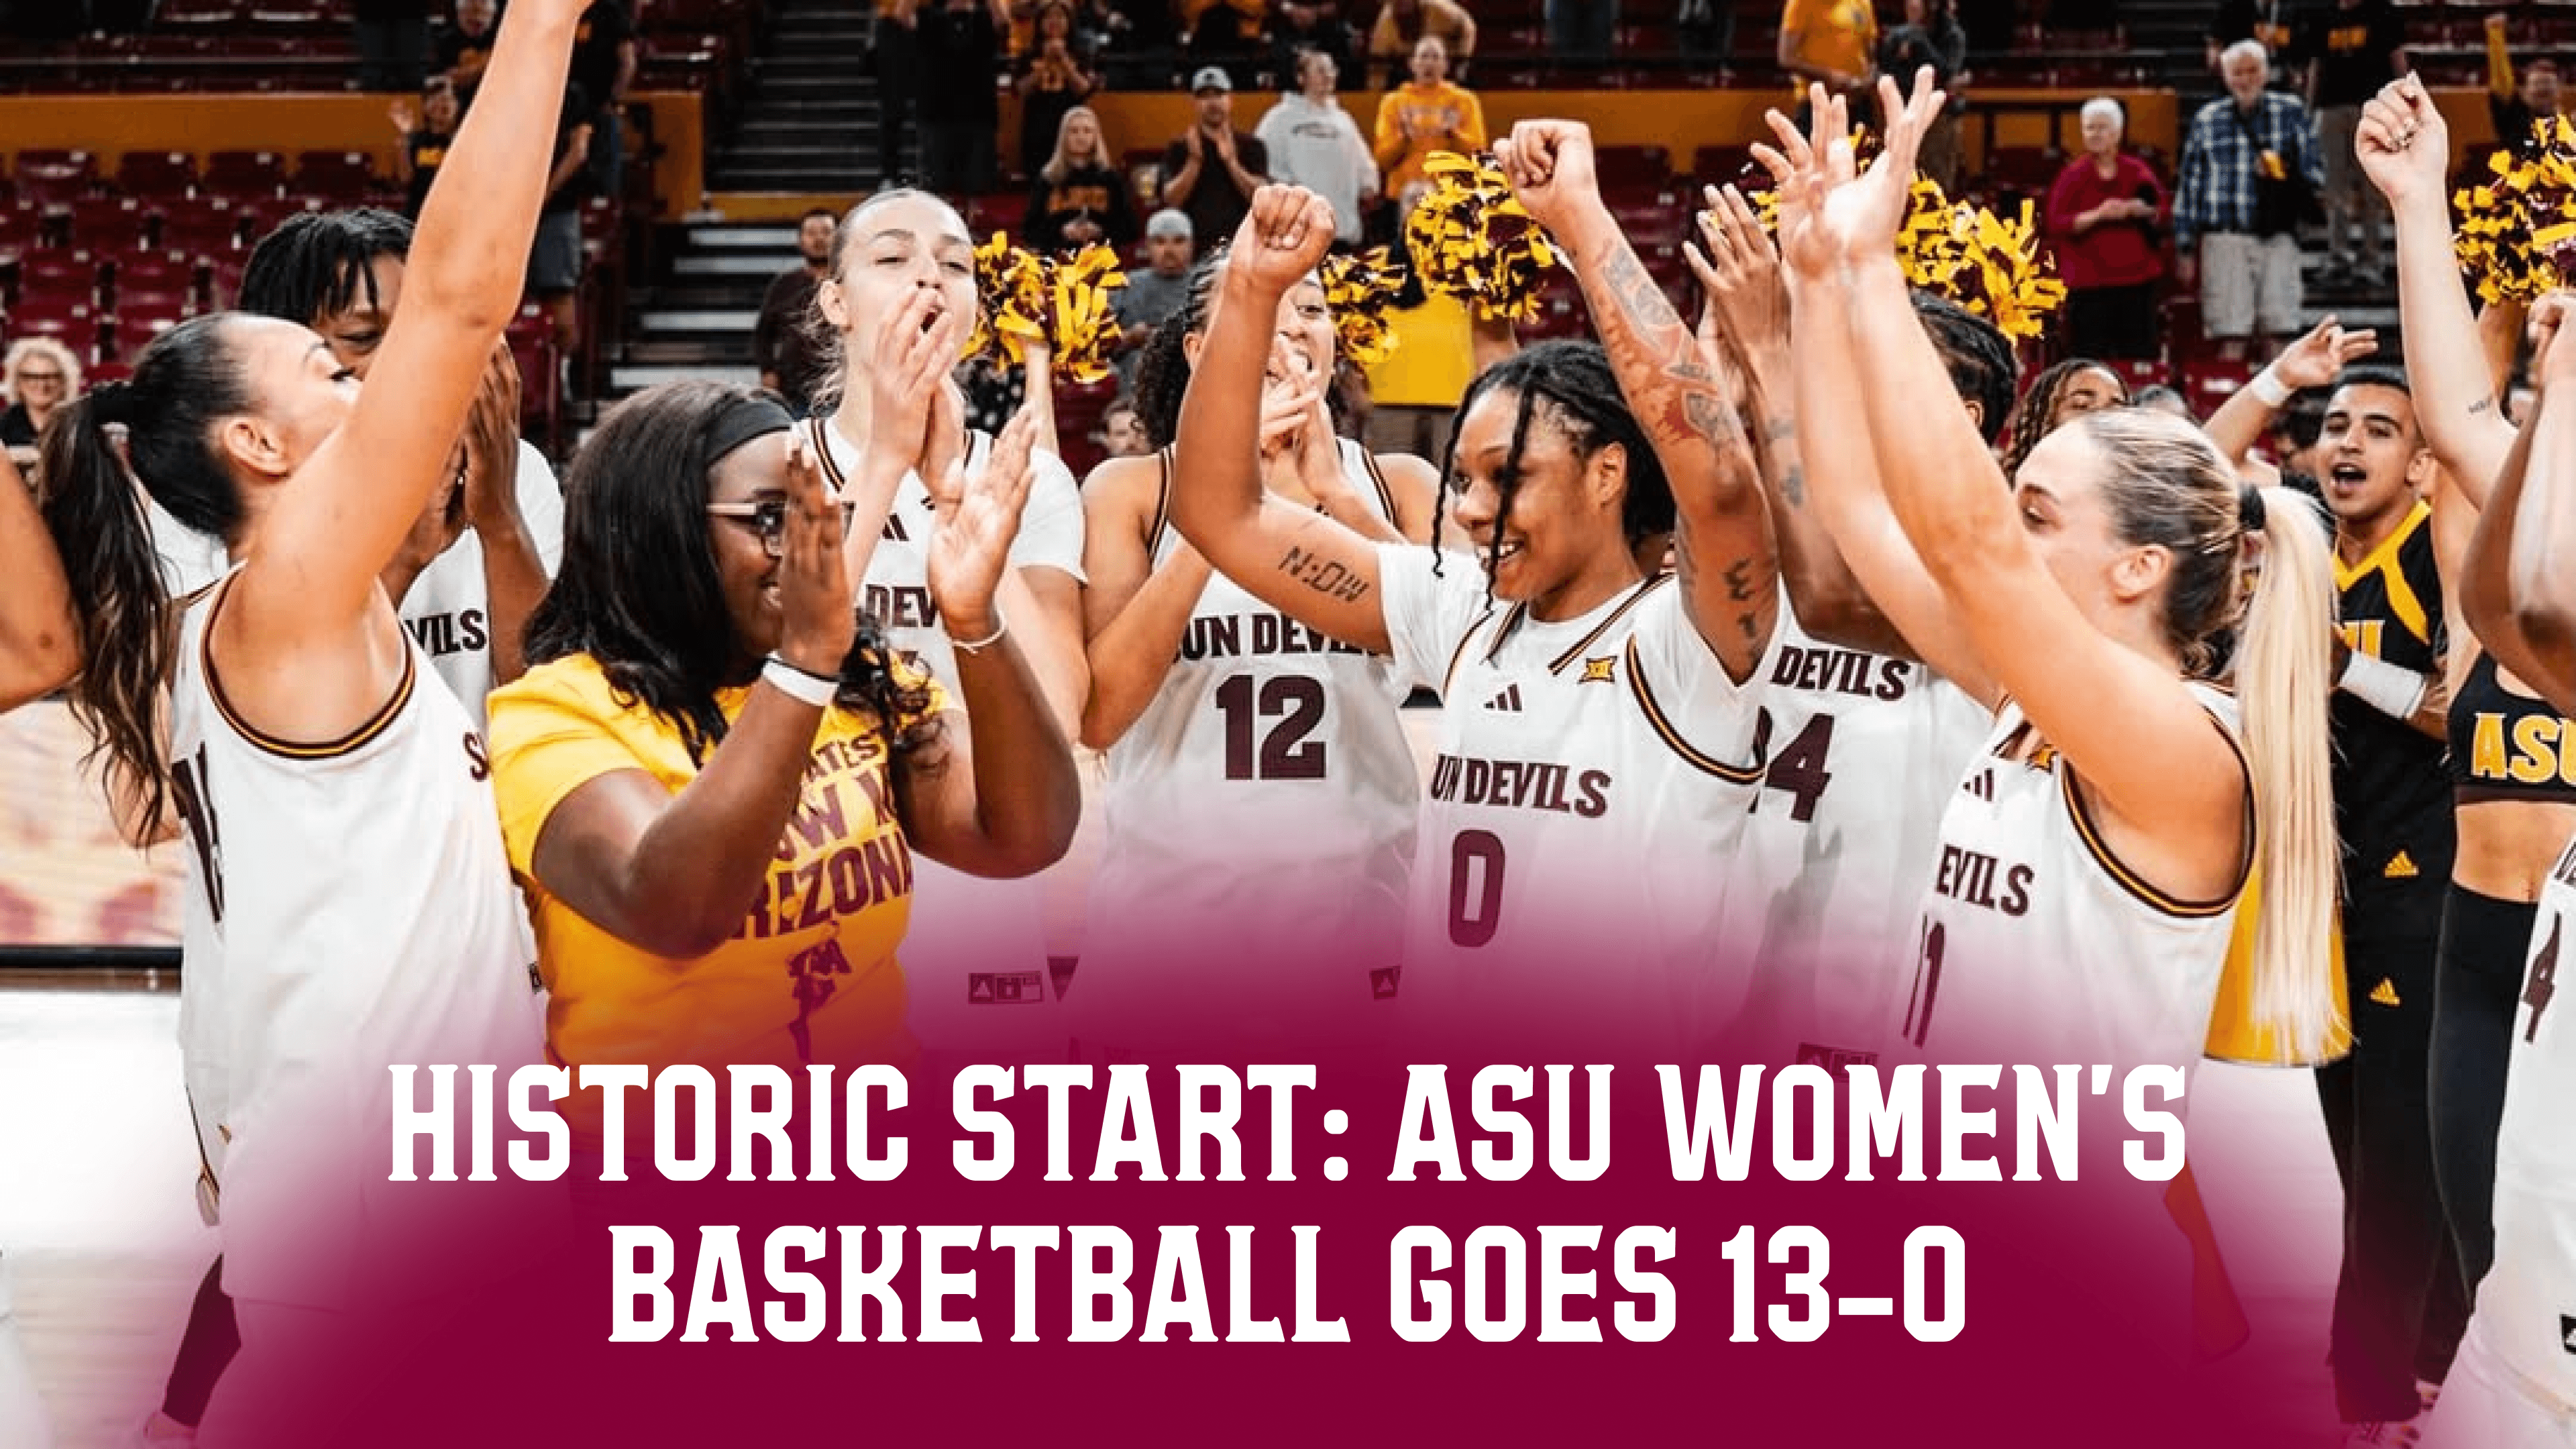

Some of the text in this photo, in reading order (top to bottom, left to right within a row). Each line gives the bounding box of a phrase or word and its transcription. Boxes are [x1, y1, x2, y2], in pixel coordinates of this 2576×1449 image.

[1179, 615, 1241, 661] UN
[1770, 645, 1911, 701] DEVILS
[1216, 674, 1327, 781] 12
[1461, 757, 1613, 818] DEVILS
[1448, 828, 1506, 949] 0
[1935, 843, 2035, 916] EVILS
